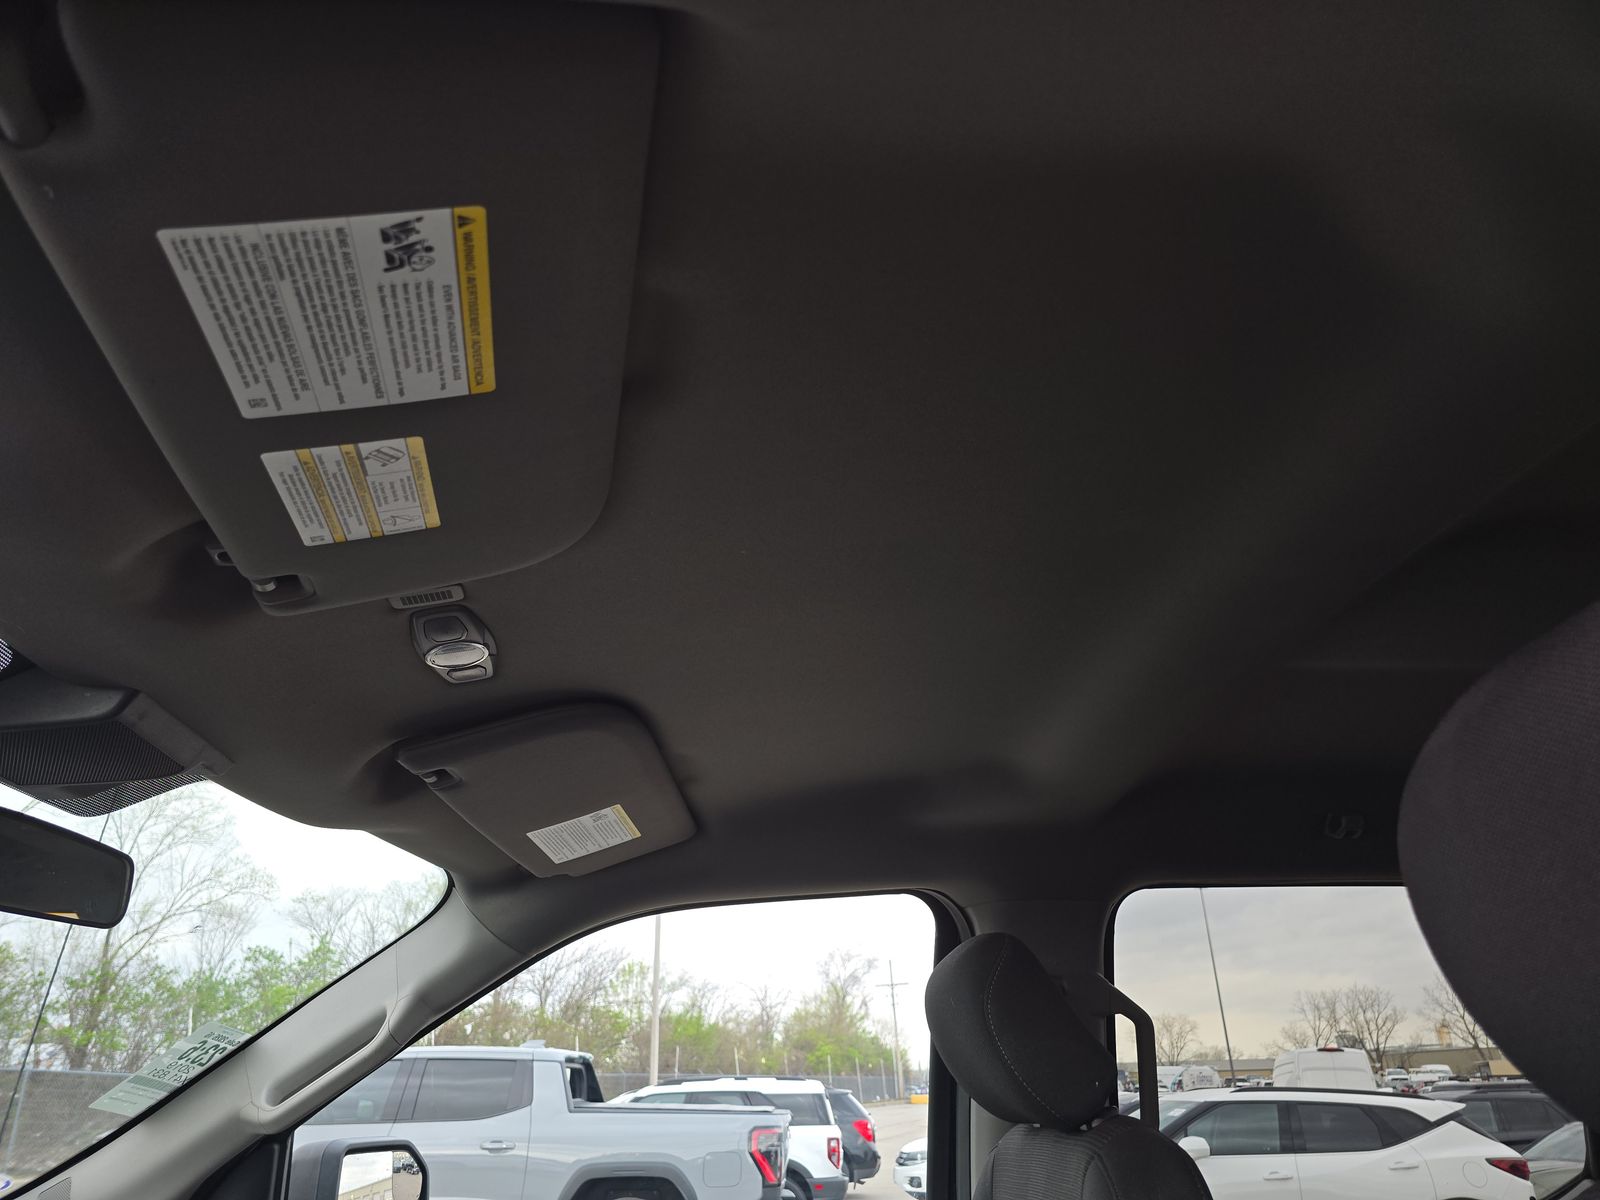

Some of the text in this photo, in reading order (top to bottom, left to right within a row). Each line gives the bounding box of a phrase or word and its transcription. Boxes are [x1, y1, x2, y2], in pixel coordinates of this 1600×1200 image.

[341, 251, 354, 270] AVEC
[463, 231, 475, 271] WARNING
[250, 243, 272, 282] INCLUSIVE
[346, 272, 358, 287] DES
[265, 284, 277, 300] CON
[270, 301, 283, 315] LAS
[277, 316, 293, 342] NUEVAS
[355, 309, 372, 351] GONFLABLES
[442, 284, 461, 381] EVEN WITH ADVANCED AIR BAGS
[286, 343, 302, 368] BOLSAS
[294, 369, 305, 377] DE
[298, 378, 310, 391] AIRE
